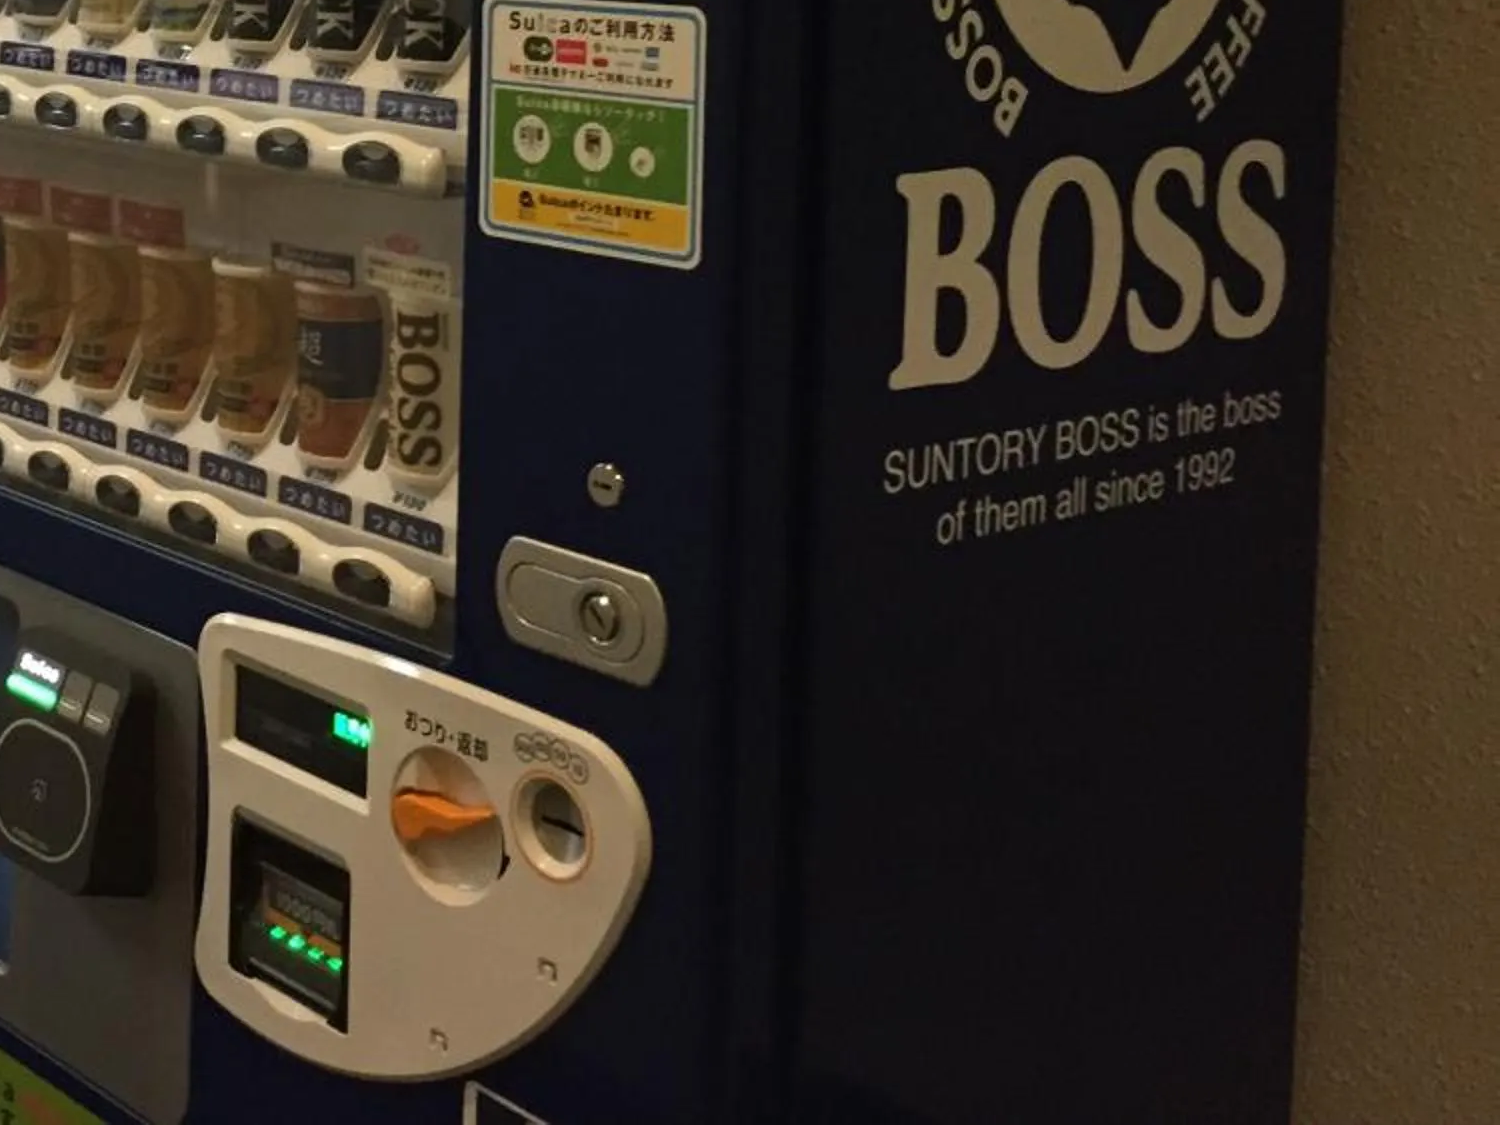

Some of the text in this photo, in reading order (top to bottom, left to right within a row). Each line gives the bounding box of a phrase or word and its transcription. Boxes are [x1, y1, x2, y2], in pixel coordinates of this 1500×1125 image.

[509, 10, 676, 44] Suicaのご利用方法
[887, 137, 1287, 391] BOSS
[396, 311, 442, 467] BOSS
[883, 390, 1283, 495] SUNTORY BOSS is the boss
[369, 513, 437, 546] つめたい
[936, 447, 1237, 546] of them all since 1992
[403, 709, 490, 763] おつり・返却
